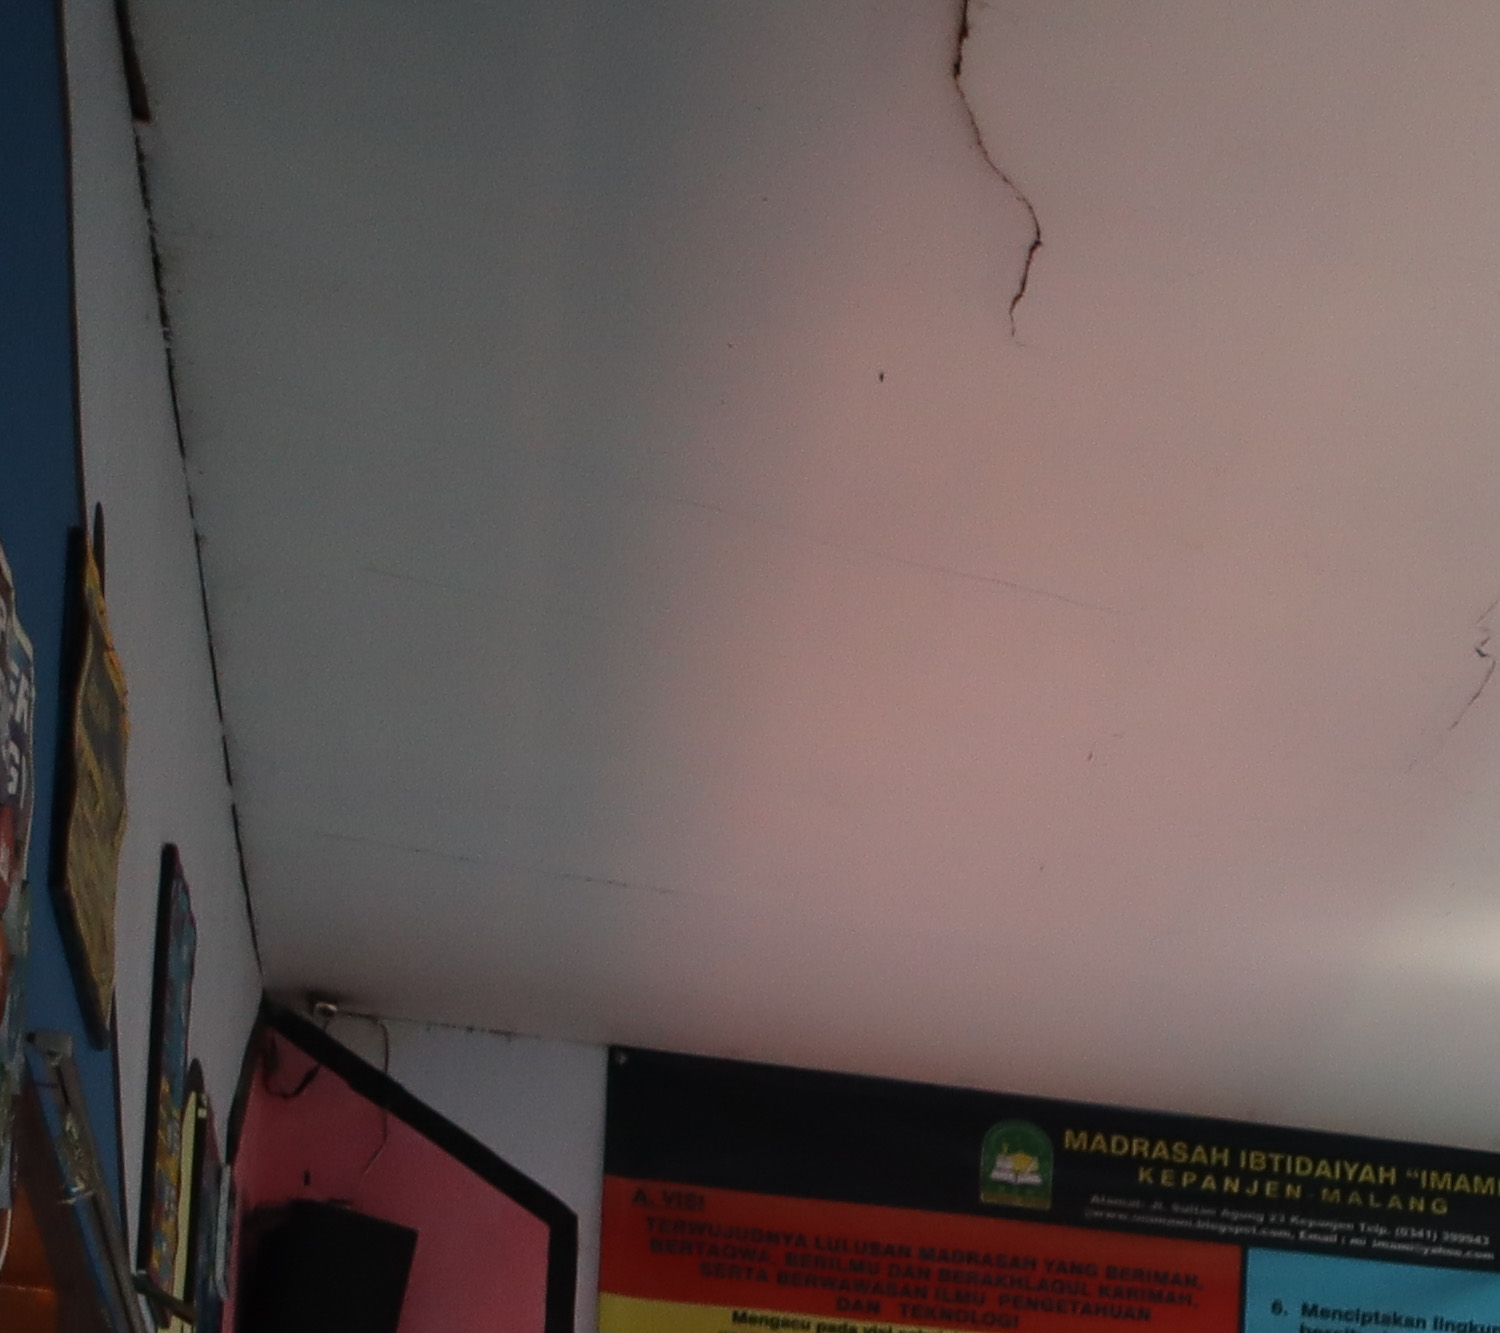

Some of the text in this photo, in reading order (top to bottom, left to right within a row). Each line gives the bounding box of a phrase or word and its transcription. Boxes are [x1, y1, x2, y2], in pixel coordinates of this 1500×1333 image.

[1064, 1129, 1228, 1167] MADRASAH
[1239, 1149, 1396, 1185] IBTIDAIYAH
[731, 1310, 811, 1331] Mengacu
[1300, 1301, 1426, 1330] Menciptakan
